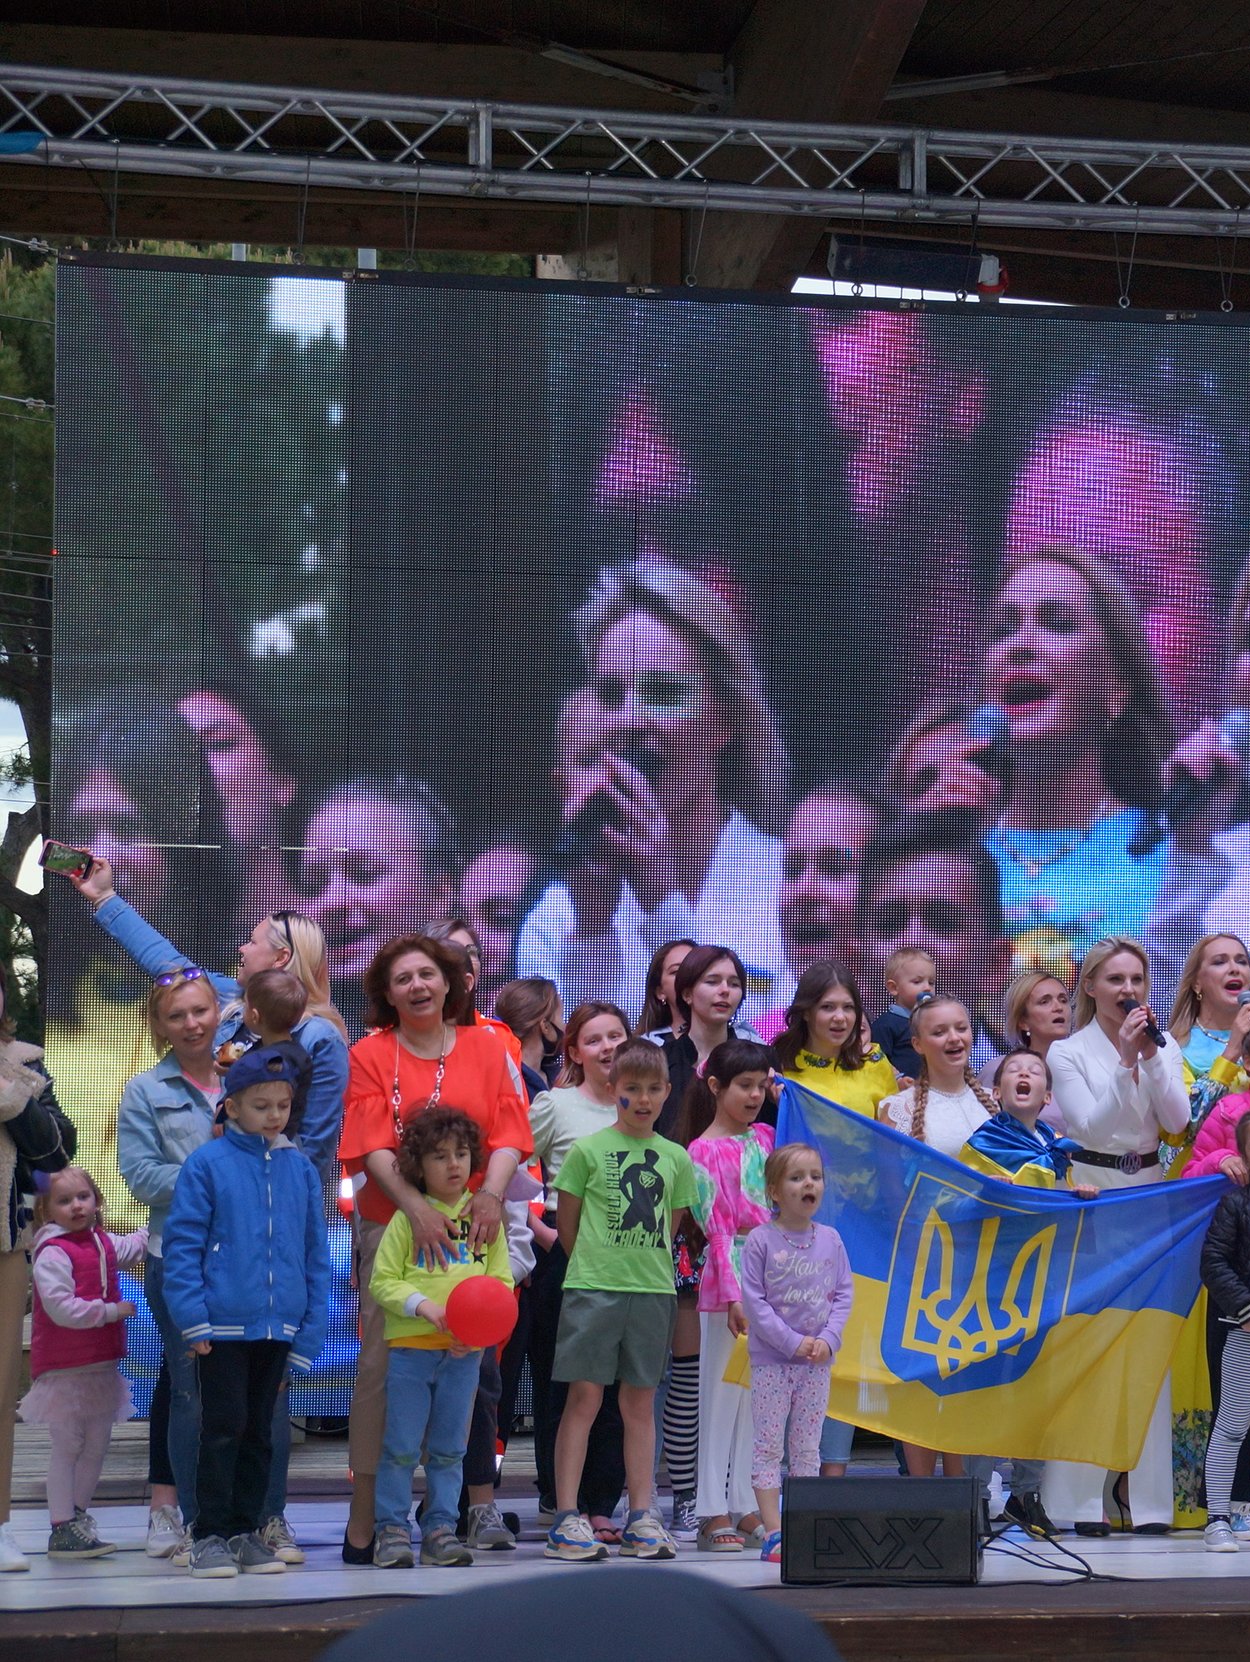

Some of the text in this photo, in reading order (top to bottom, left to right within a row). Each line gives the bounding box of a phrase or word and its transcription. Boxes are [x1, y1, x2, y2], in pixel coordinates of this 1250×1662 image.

[607, 1193, 620, 1230] SUPER
[604, 1229, 662, 1249] ACADEMY
[766, 1251, 822, 1283] Have
[783, 1285, 826, 1308] lovely
